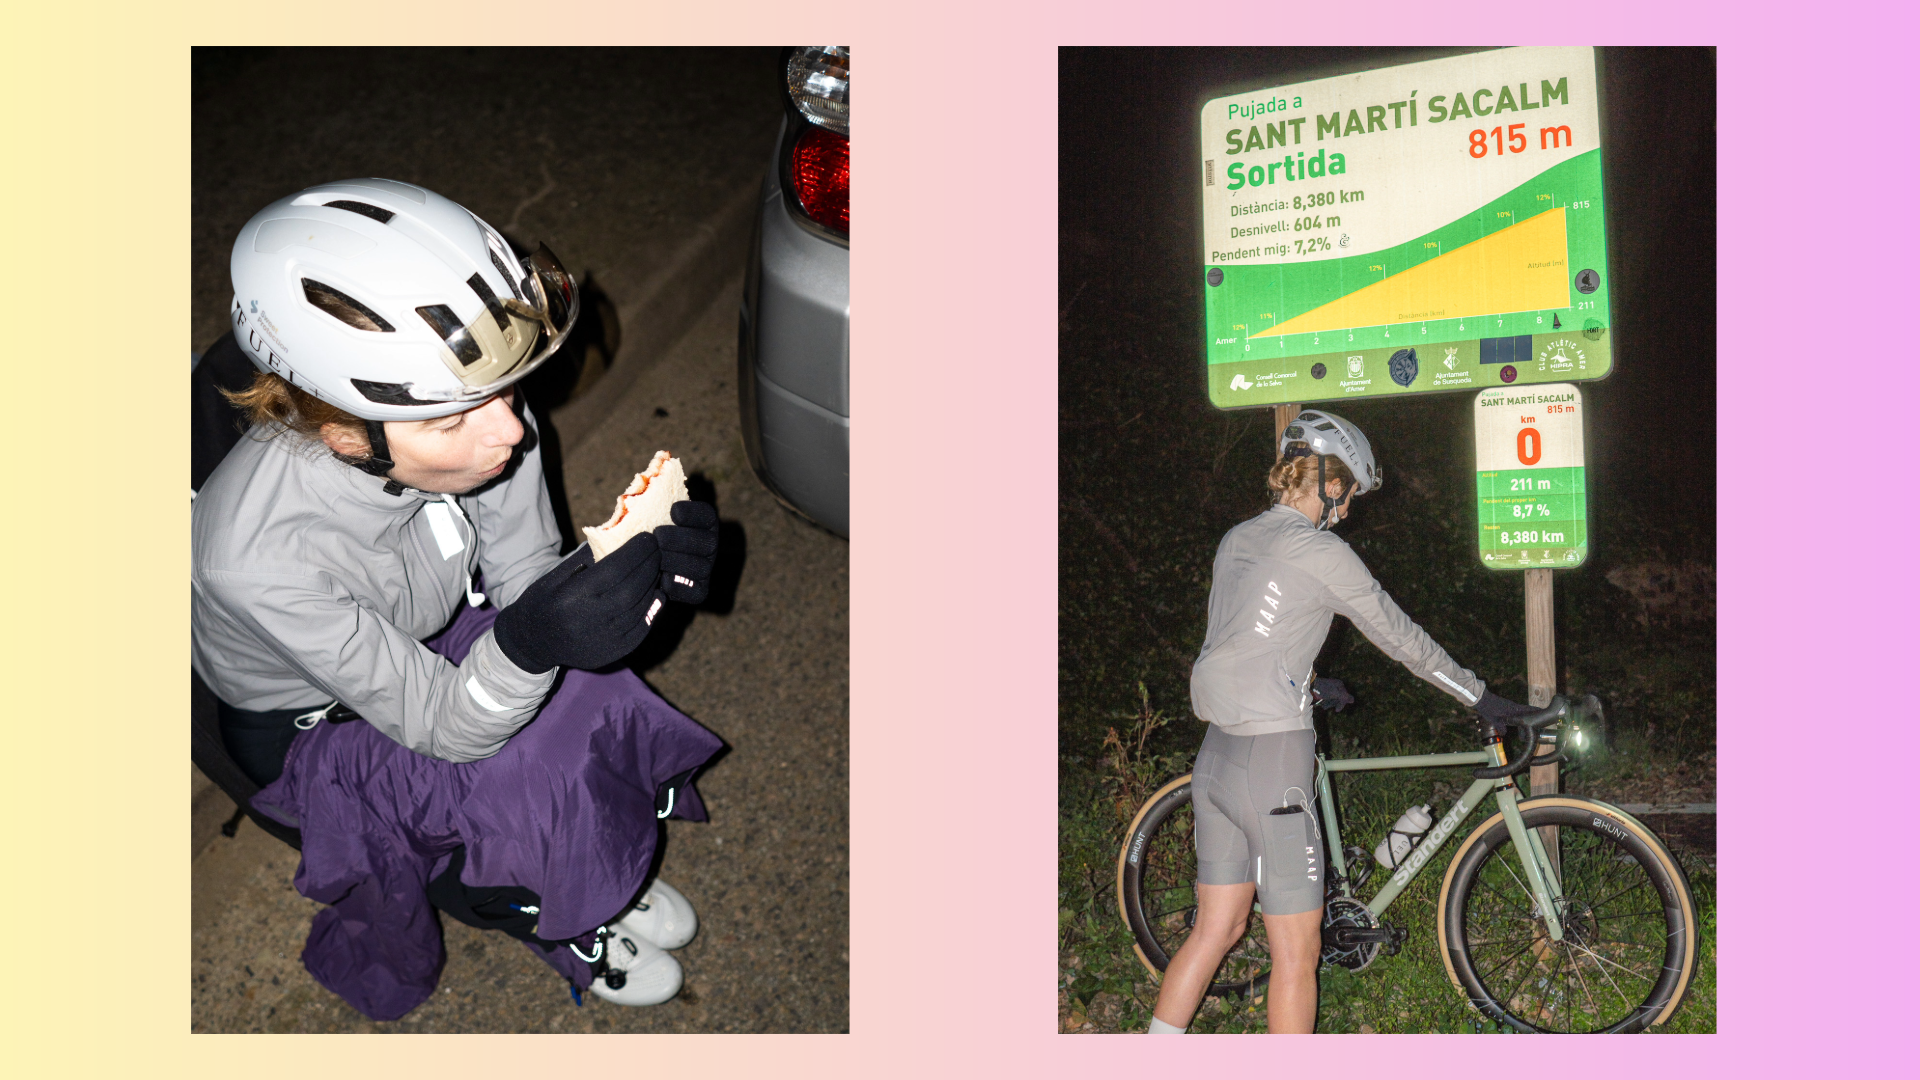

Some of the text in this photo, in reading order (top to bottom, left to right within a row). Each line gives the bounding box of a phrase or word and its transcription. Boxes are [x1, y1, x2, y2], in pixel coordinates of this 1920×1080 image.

[1228, 96, 1302, 120] Pujada a
[1225, 77, 1569, 155] SANT MARTÍ SACALM
[1469, 123, 1572, 159] 815 m
[1226, 148, 1346, 191] Sortida
[1230, 189, 1365, 217] Distància: 8,380 km
[1573, 200, 1590, 210] 815
[1496, 211, 1511, 219] 10%
[1230, 215, 1341, 238] Desnivell: 604 m
[1212, 236, 1331, 262] Pendent mig: 7,2%
[1369, 264, 1383, 272] 12%
[1578, 301, 1595, 310] 211
[260, 310, 279, 334] Sweet
[1459, 323, 1465, 331] 6
[1497, 319, 1503, 328] 7
[1536, 316, 1542, 324] 8
[257, 316, 289, 354] Protection
[1384, 330, 1390, 338] 4
[1421, 327, 1427, 335] 5
[1215, 337, 1238, 345] Amer
[1245, 344, 1250, 352] 0
[1314, 337, 1319, 345] 2
[1538, 351, 1548, 371] CLUB
[1575, 349, 1586, 370] AMER
[1550, 361, 1574, 369] HIPRA
[1435, 370, 1469, 380] Ajuntament
[1339, 378, 1371, 387] Ajuntament
[1481, 393, 1575, 407] SANT MARTÍ SACALM
[1547, 404, 1563, 413] 815
[1520, 415, 1536, 423] km
[1517, 427, 1541, 466] 0
[1510, 478, 1551, 491] 211 m
[1513, 503, 1550, 519] 8,7 %
[1500, 530, 1564, 546] 8,380 km
[1254, 580, 1282, 638] MAAP
[1601, 820, 1629, 841] HUNT
[1133, 831, 1146, 856] HUNT
[1393, 799, 1469, 886] Standert
[1305, 846, 1318, 882] MAAP
